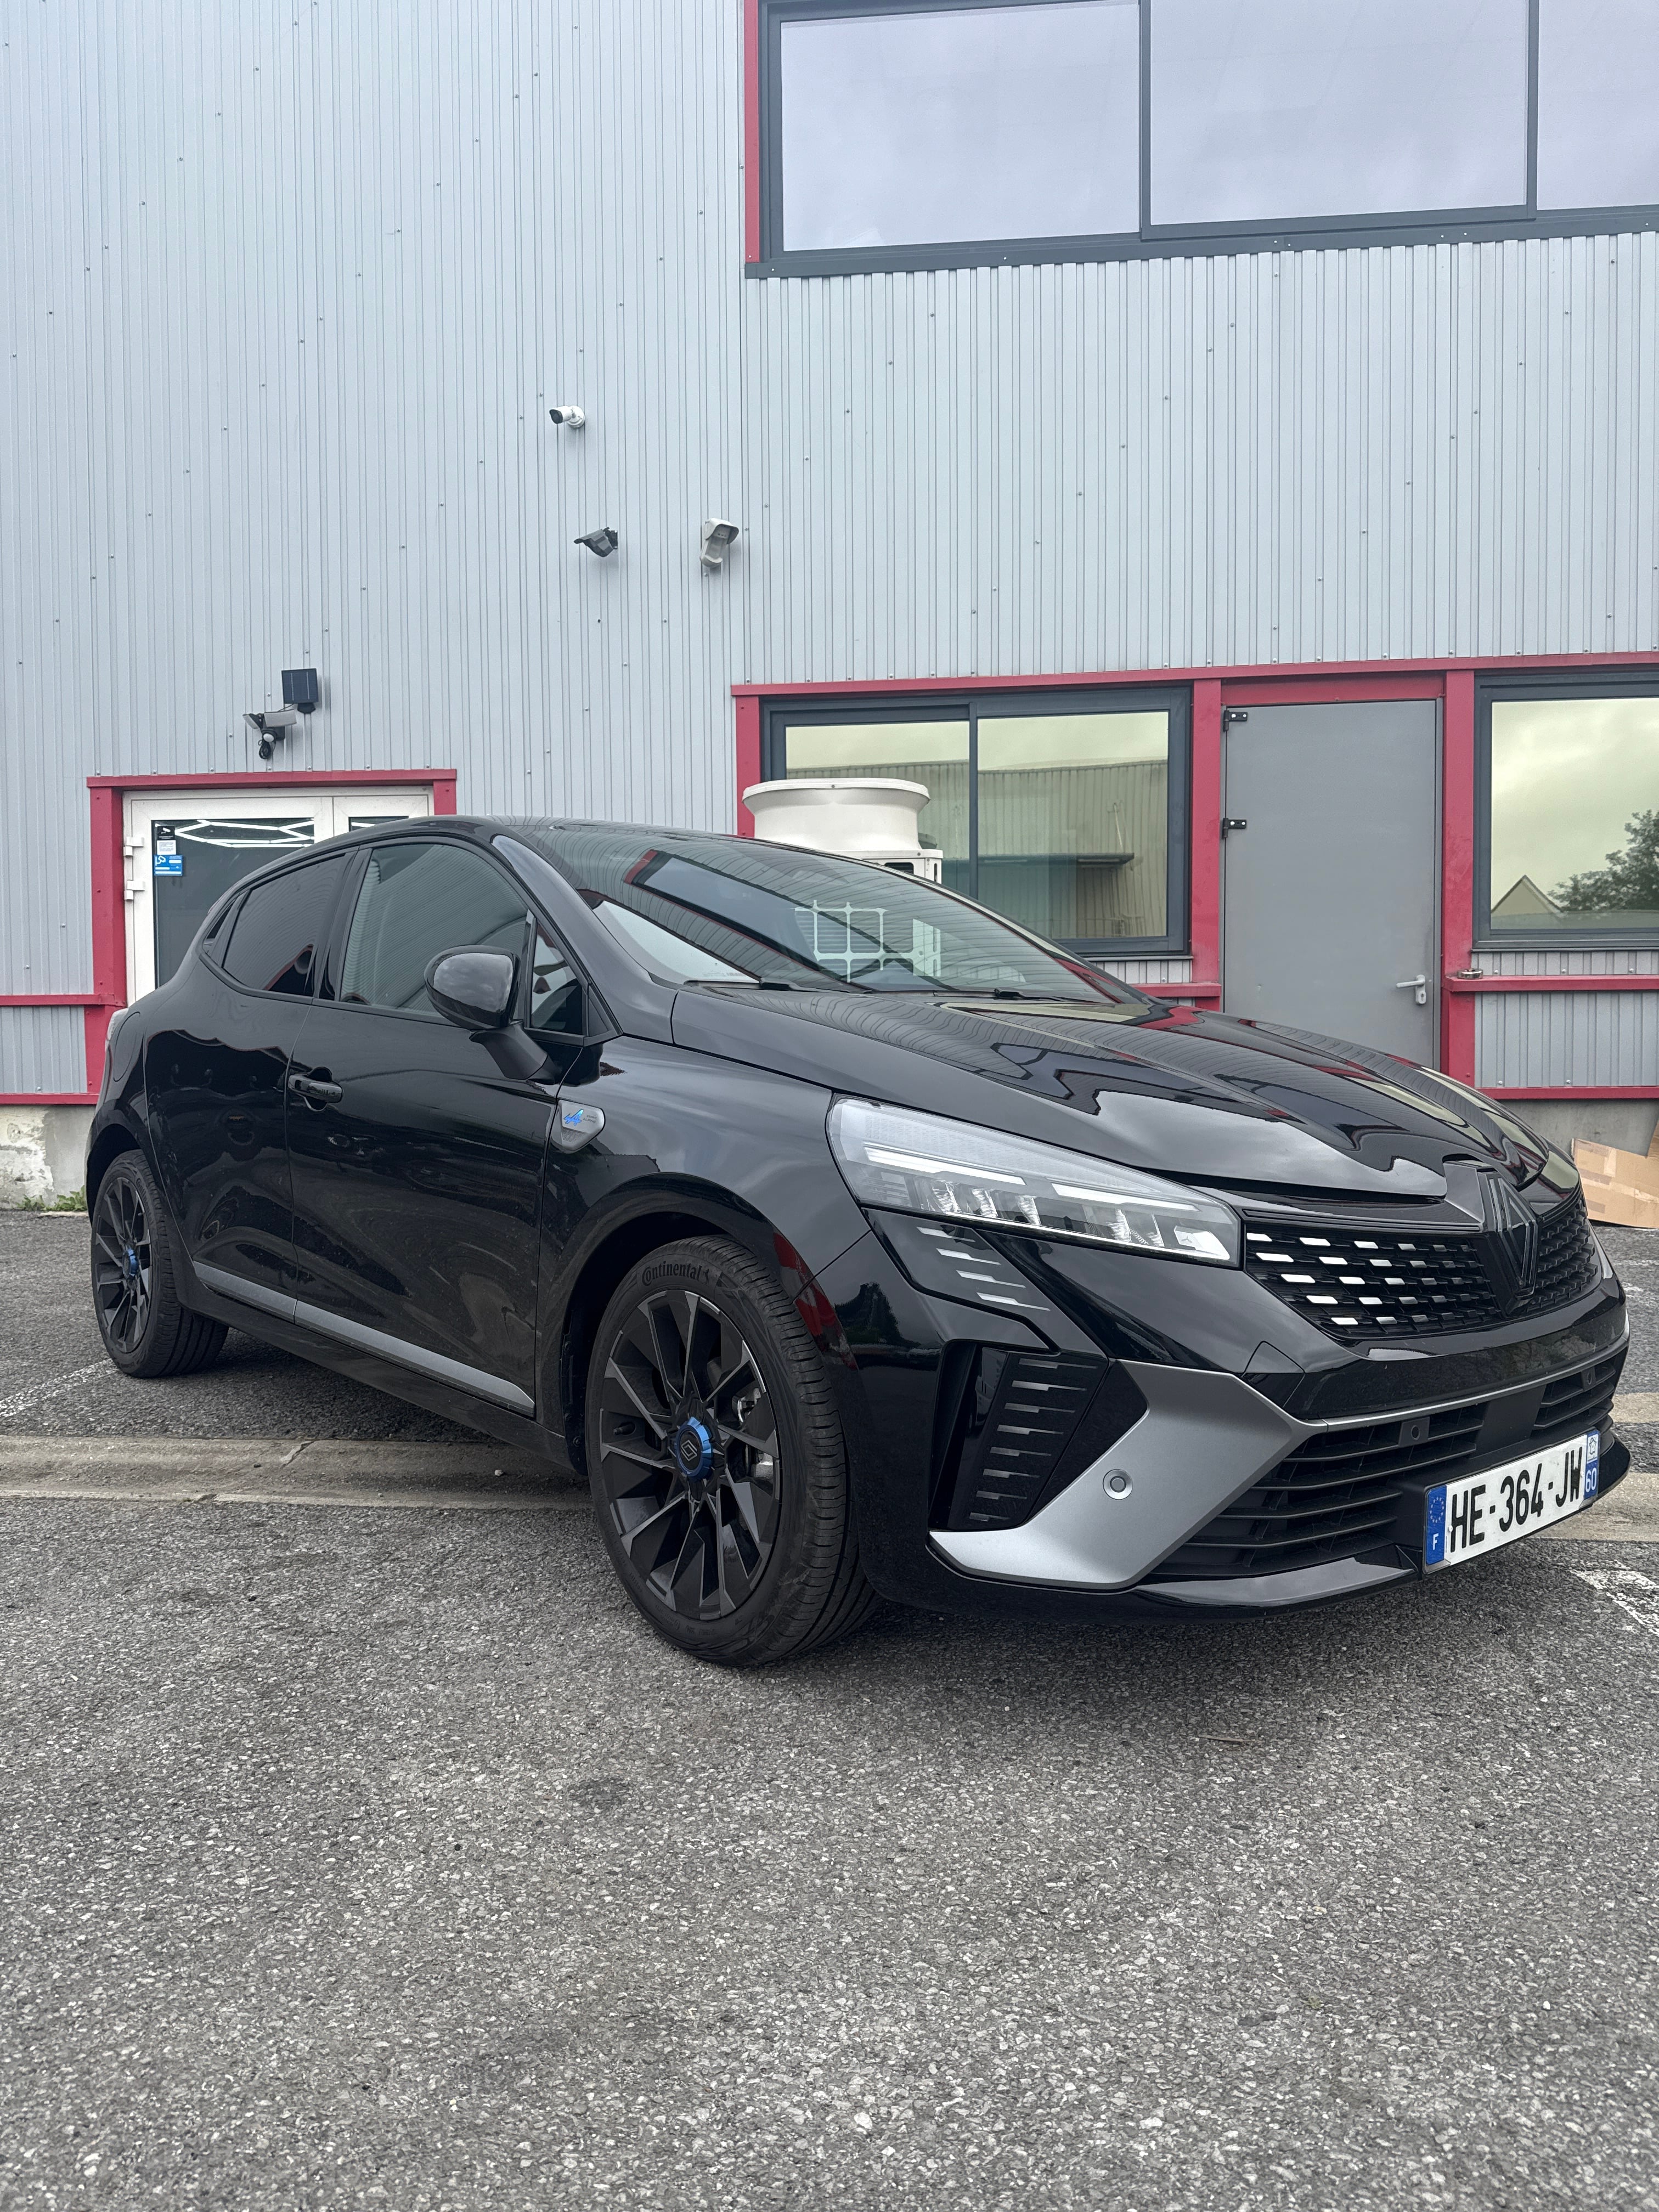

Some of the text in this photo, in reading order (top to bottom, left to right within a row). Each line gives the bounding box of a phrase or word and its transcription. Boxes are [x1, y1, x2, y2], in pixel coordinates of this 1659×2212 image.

[642, 1261, 702, 1286] Continental
[1585, 1468, 1597, 1493] 60
[1432, 1446, 1583, 1553] F HE-364-JW
